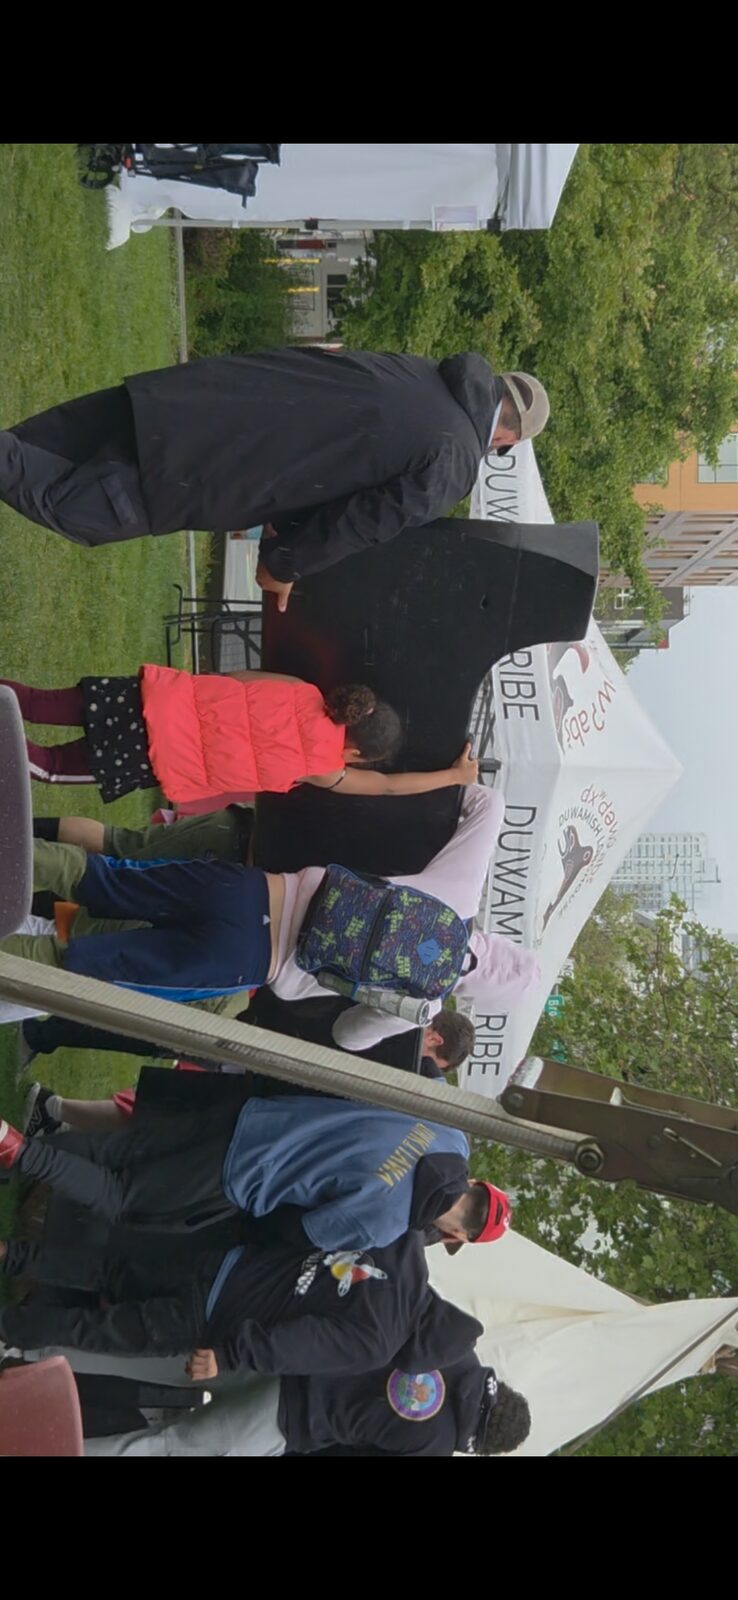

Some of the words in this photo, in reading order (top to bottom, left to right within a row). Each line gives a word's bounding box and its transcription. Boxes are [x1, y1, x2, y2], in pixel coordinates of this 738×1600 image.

[498, 651, 540, 721] RIBE
[490, 804, 537, 943] DUWAM
[548, 1000, 560, 1016] Bro
[468, 1014, 508, 1076] RIBE
